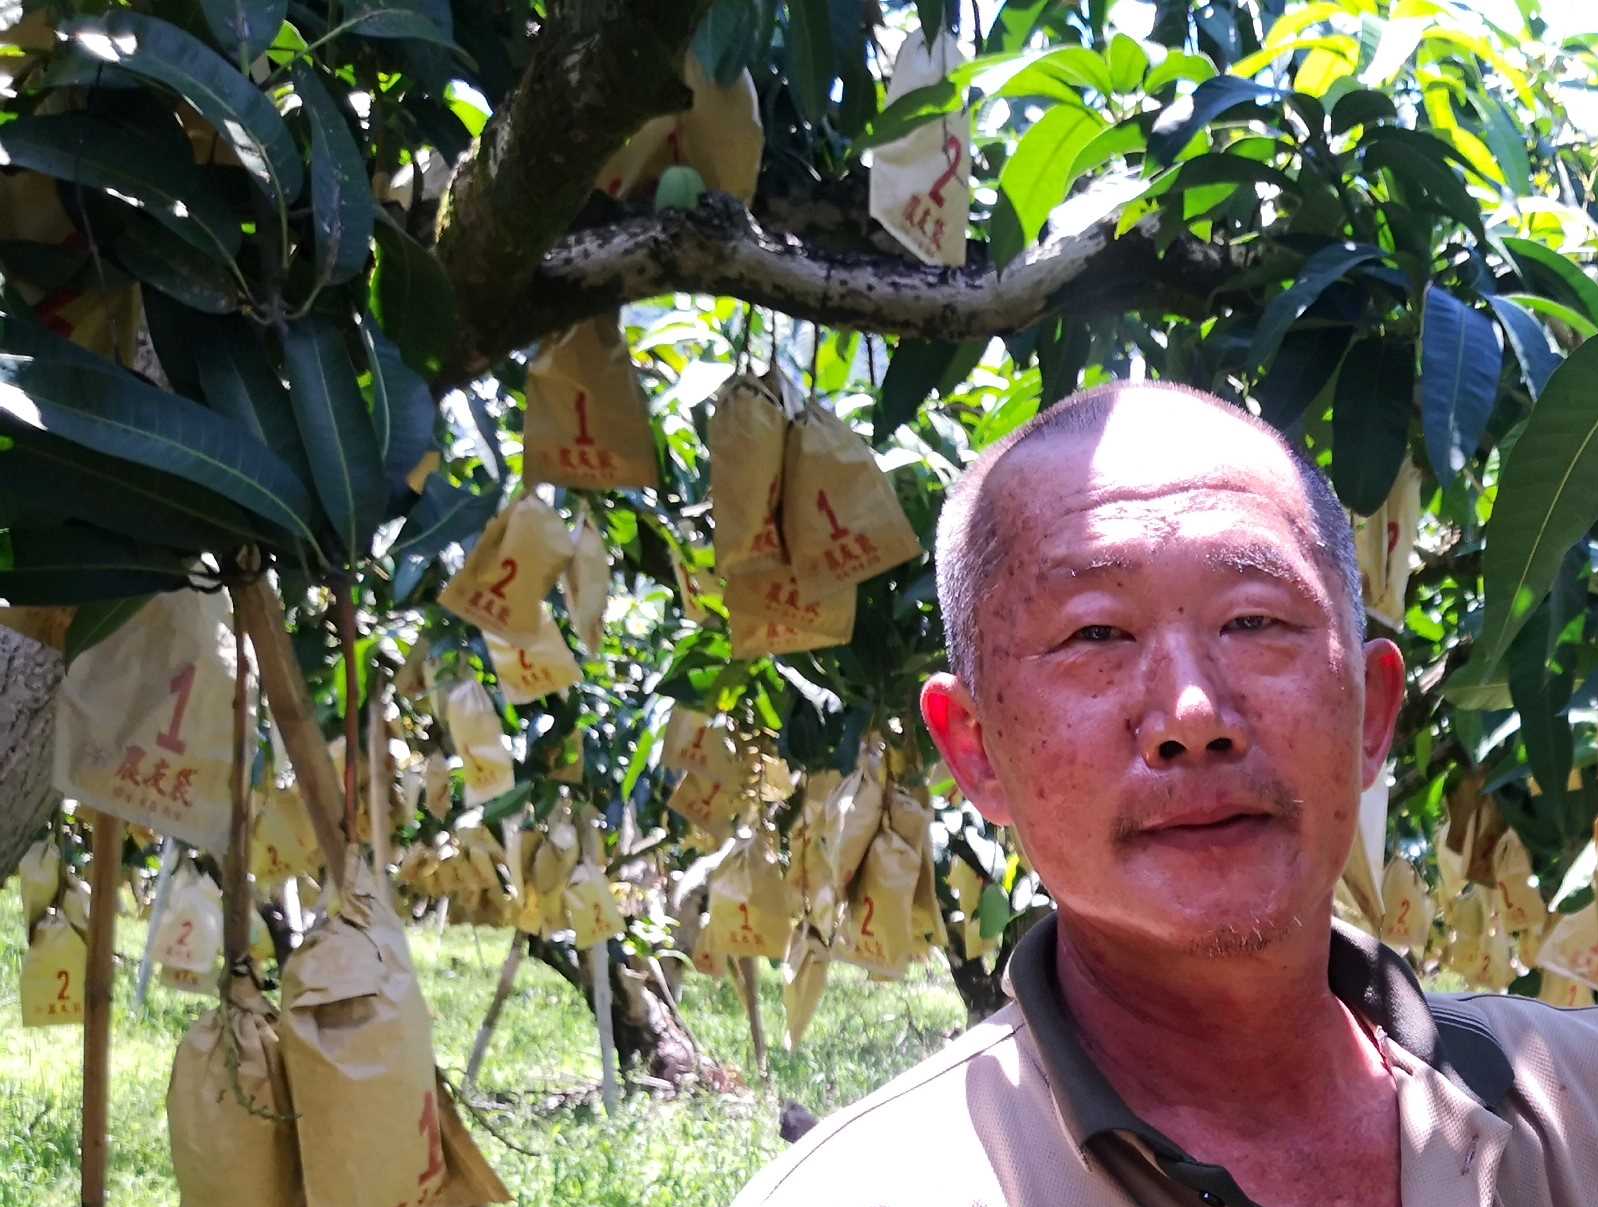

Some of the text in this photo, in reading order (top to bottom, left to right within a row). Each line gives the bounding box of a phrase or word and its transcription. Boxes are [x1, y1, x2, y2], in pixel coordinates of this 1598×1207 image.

[928, 135, 962, 209] 2
[574, 391, 595, 446] 1
[817, 487, 850, 541] 1
[490, 559, 518, 600] 2
[157, 663, 196, 756] 1
[177, 920, 194, 946] 2
[861, 896, 876, 937] 2
[56, 970, 70, 1001] 2
